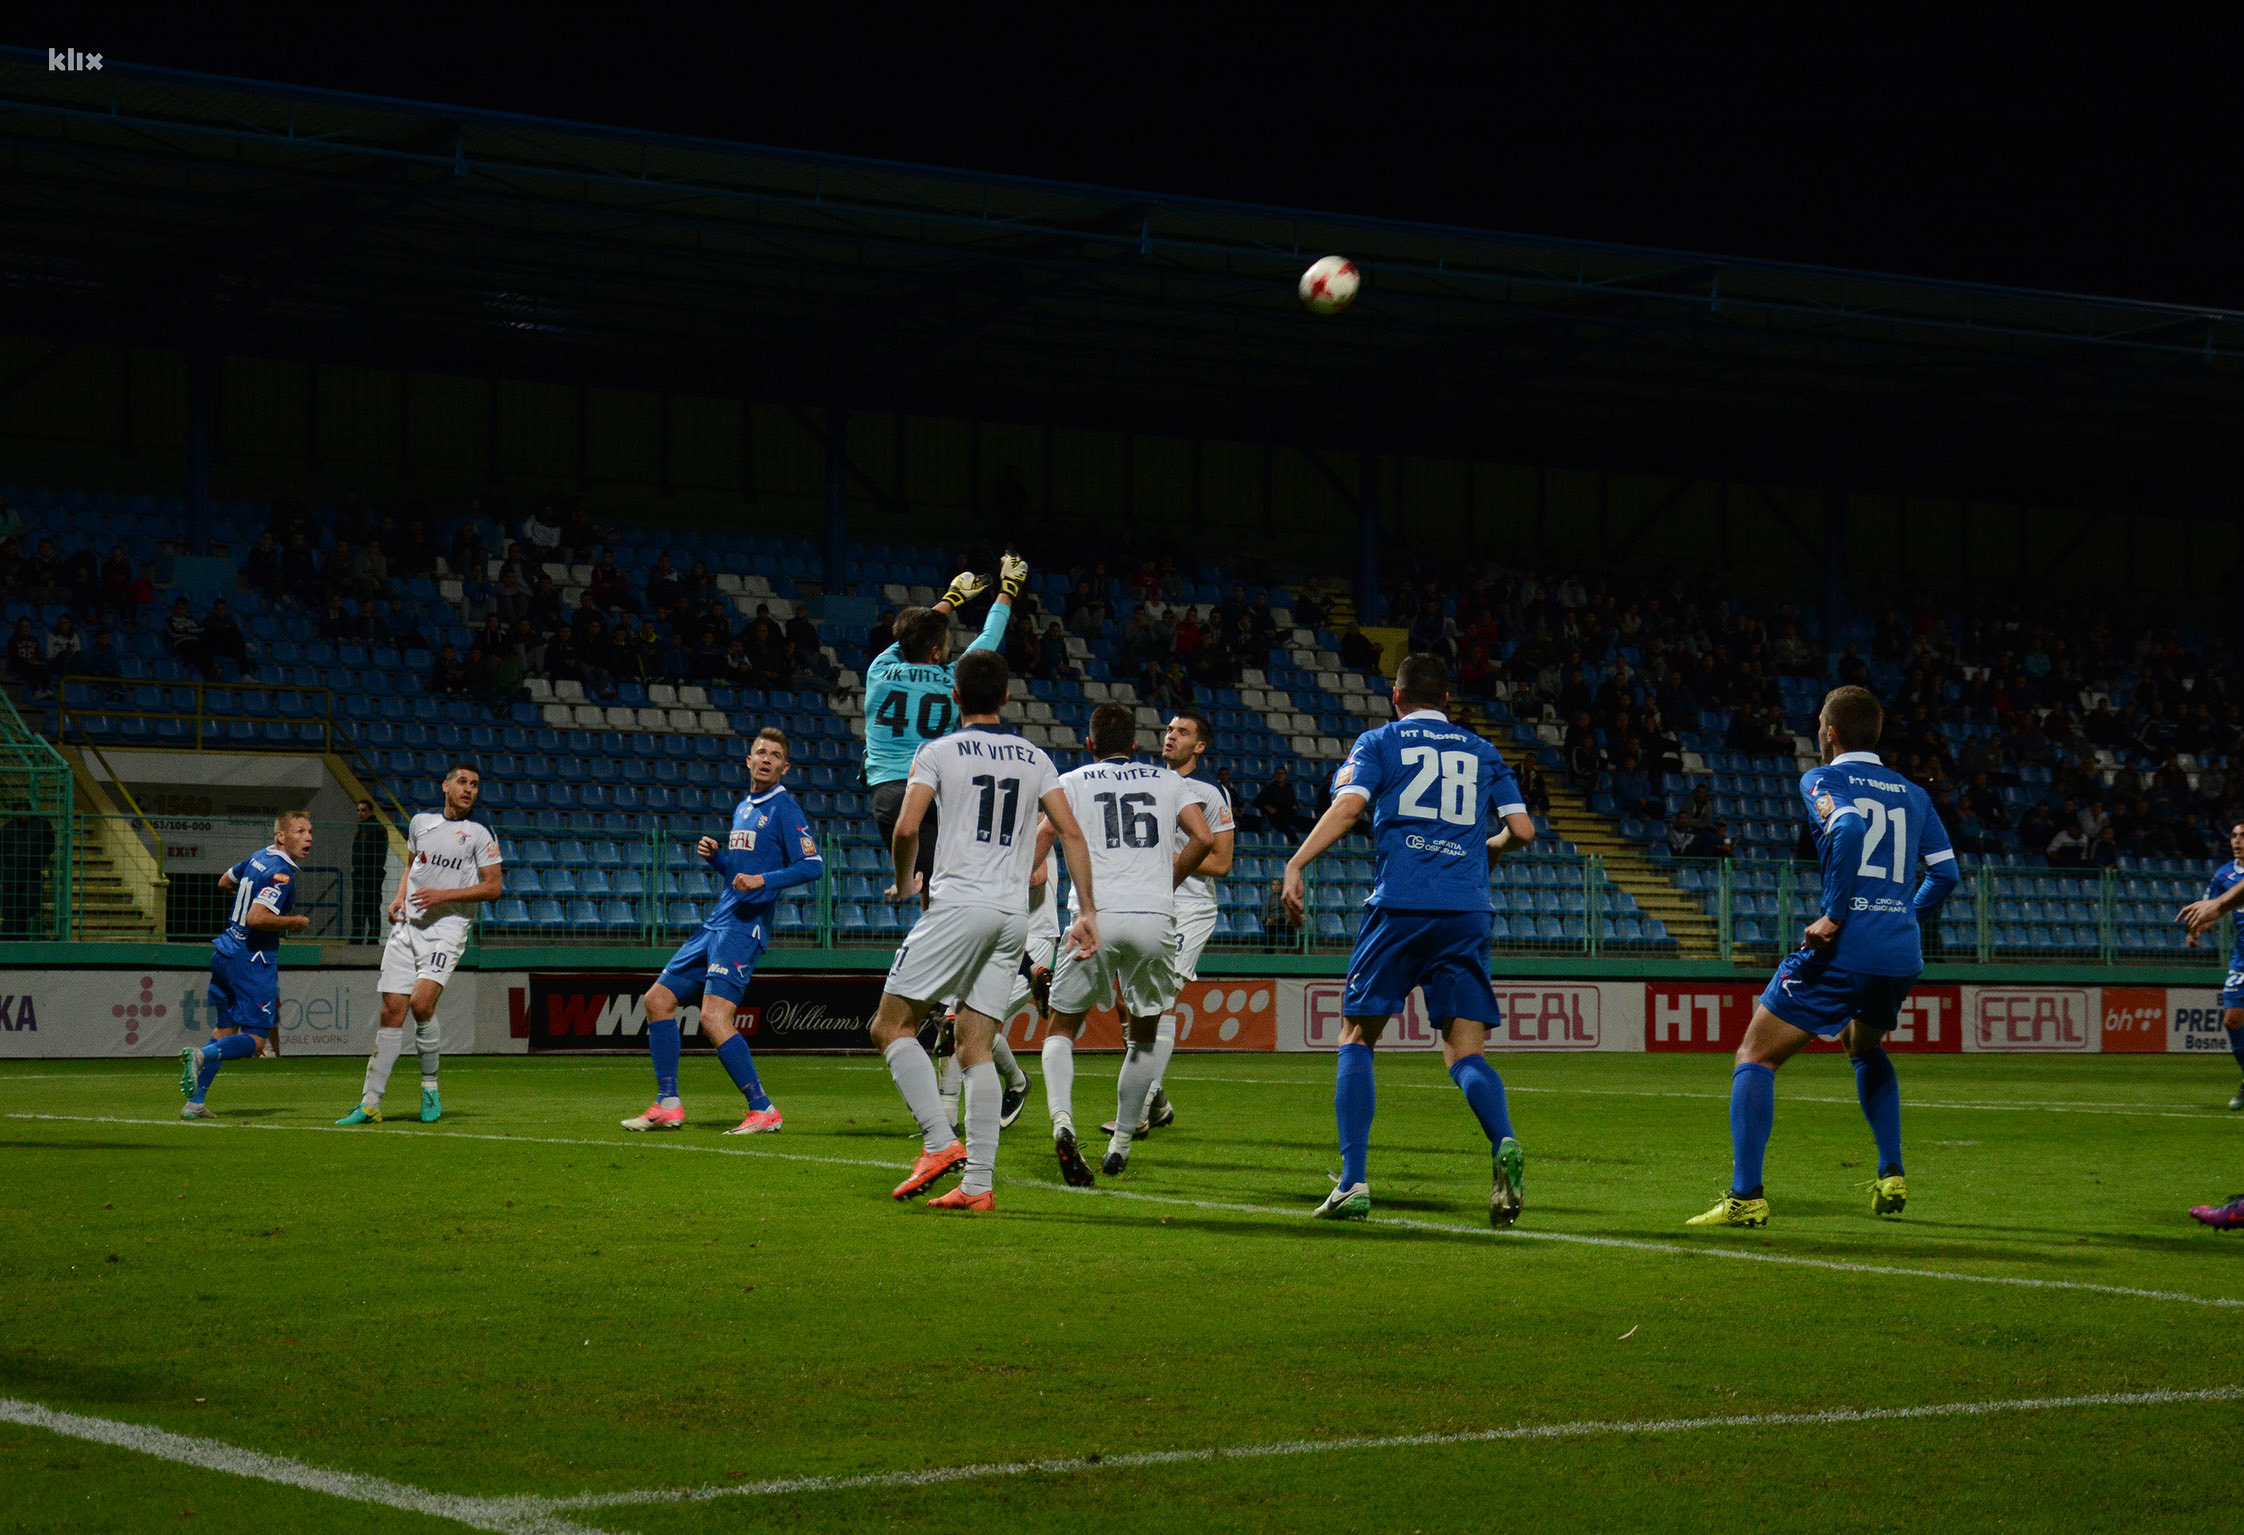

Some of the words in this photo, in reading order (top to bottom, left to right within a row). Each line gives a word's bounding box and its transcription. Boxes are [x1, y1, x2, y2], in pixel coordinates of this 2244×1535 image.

[875, 690, 952, 739] 40
[957, 740, 983, 757] NK
[987, 743, 1036, 765] VITEZ
[1084, 769, 1107, 780] NK
[1112, 768, 1161, 782] VITEZ
[1398, 746, 1478, 826] 28
[146, 820, 212, 831] 63/106-000
[972, 774, 1020, 847] 11
[1094, 792, 1160, 849] 16
[730, 831, 752, 849] EAL
[1852, 797, 1907, 884] 21
[230, 876, 254, 928] 11
[429, 951, 448, 970] 10
[766, 999, 863, 1035] Williams
[1311, 991, 1431, 1041] FL
[1655, 994, 1721, 1042] HT
[1981, 997, 2083, 1042] FEAL
[2104, 1007, 2134, 1032] bh
[279, 1035, 310, 1045] CABLE
[312, 1035, 350, 1045] WORKS
[2185, 1034, 2227, 1050] Bosne
